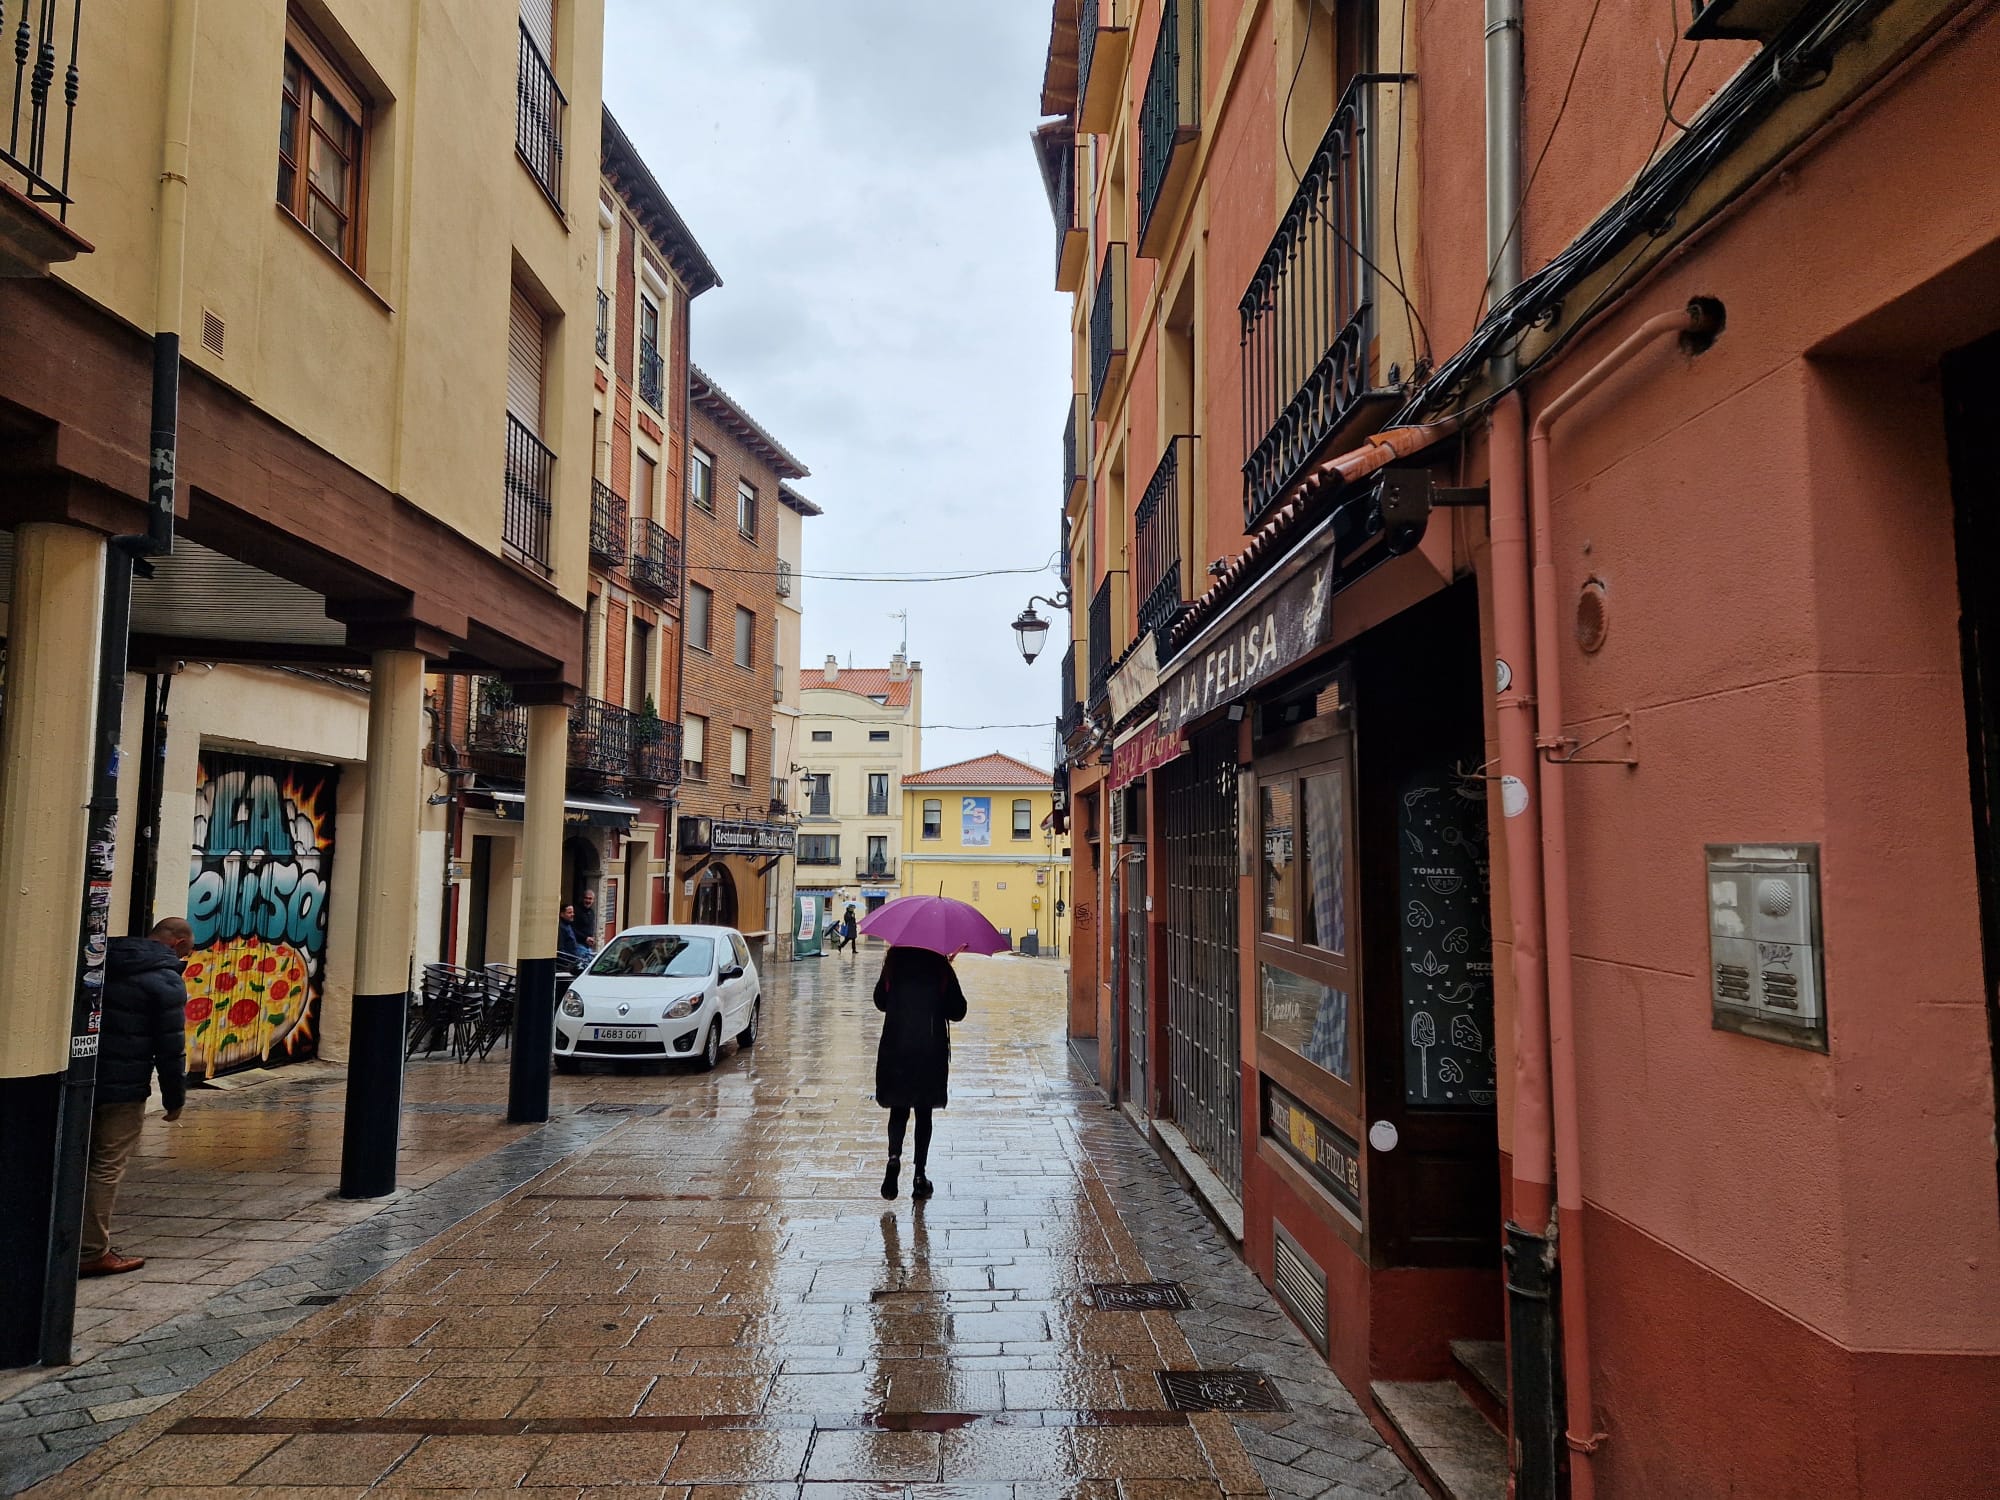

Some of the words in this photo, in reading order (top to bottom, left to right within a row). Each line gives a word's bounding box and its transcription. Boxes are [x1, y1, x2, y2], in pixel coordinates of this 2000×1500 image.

[1179, 671, 1198, 718] LA
[1203, 612, 1278, 704] FELISA
[207, 771, 292, 856] LA
[1412, 867, 1456, 875] TOMATE
[601, 1030, 623, 1040] 4683
[625, 1030, 642, 1039] GGY
